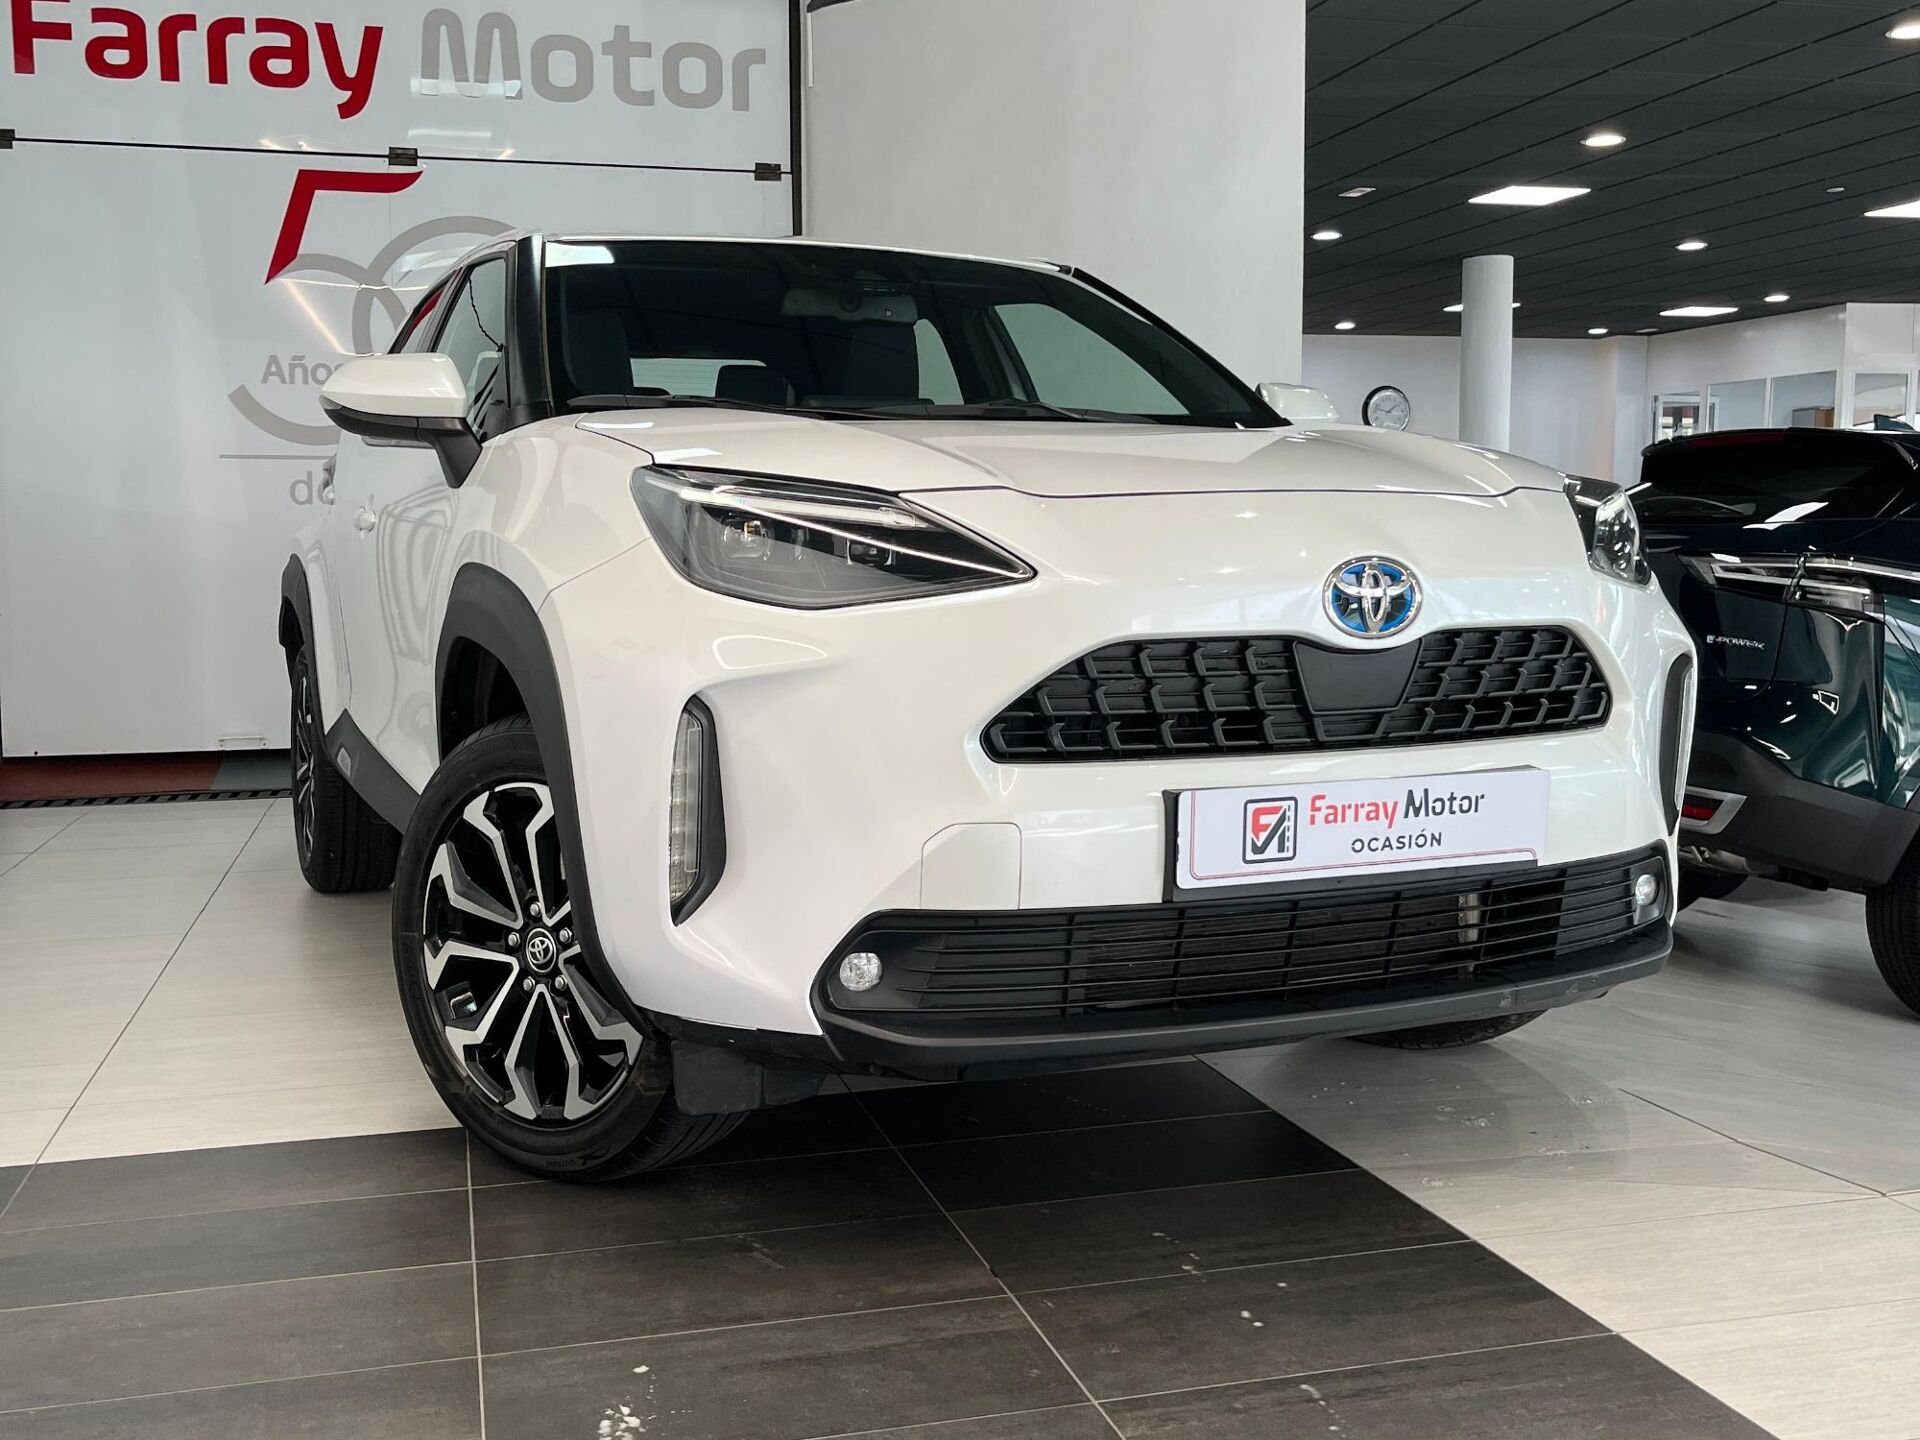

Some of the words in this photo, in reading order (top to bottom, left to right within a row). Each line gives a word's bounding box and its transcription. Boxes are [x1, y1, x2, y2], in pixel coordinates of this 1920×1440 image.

[11, 0, 384, 120] Farray
[419, 7, 767, 112] Motor
[260, 354, 345, 386] Año
[1309, 794, 1399, 829] Farray
[1403, 788, 1486, 819] Motor
[1351, 829, 1442, 854] OCASIÓN
